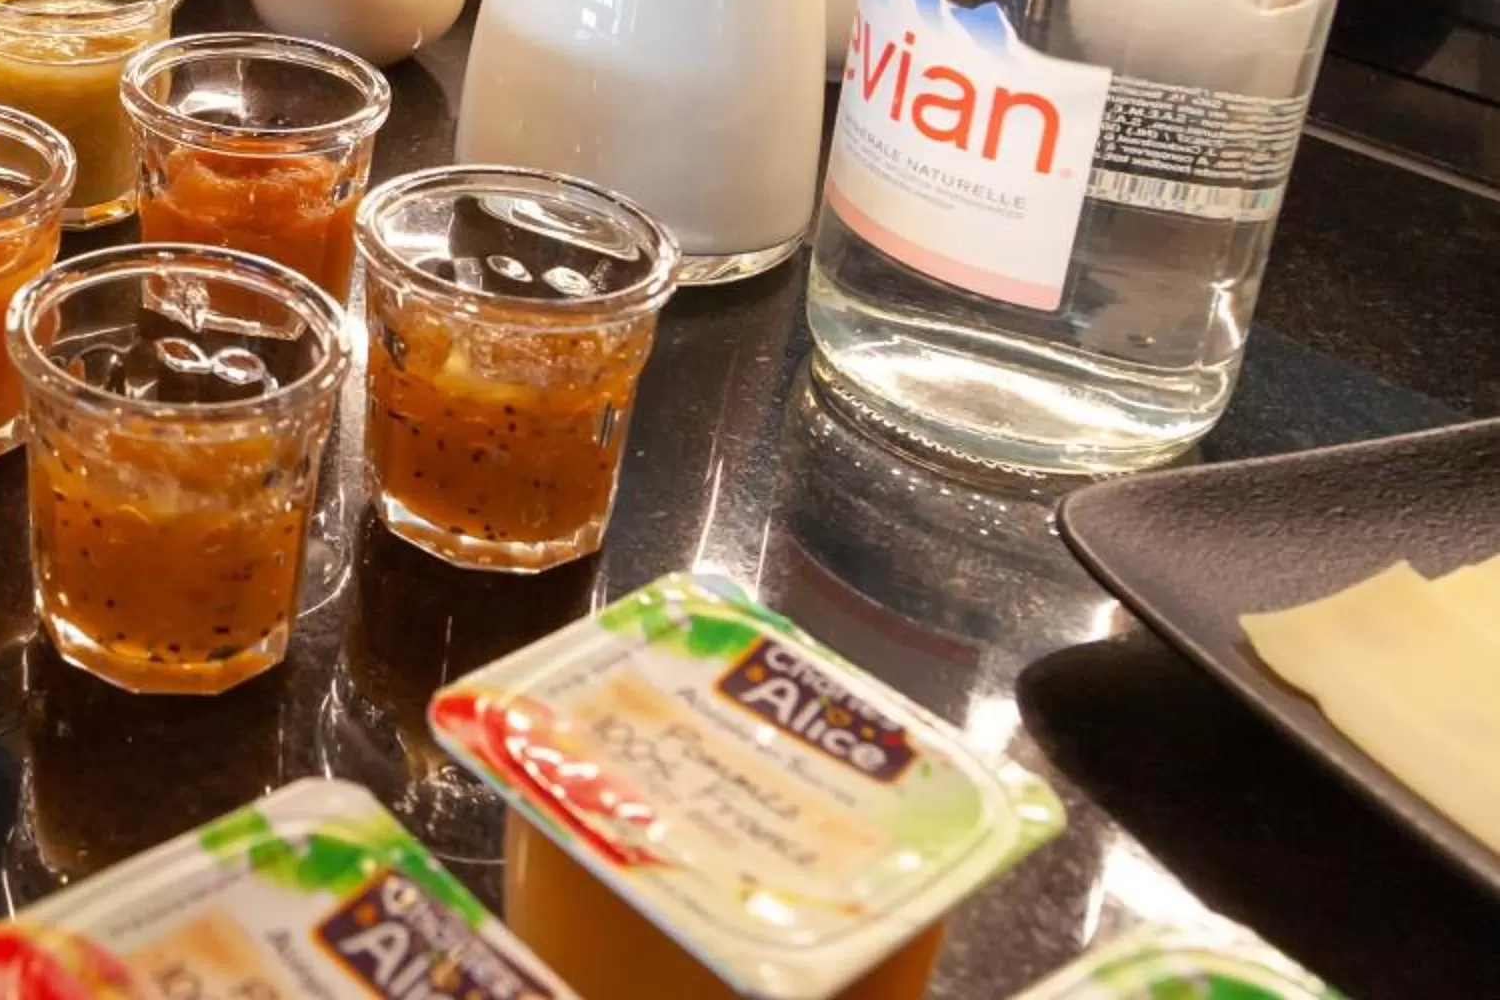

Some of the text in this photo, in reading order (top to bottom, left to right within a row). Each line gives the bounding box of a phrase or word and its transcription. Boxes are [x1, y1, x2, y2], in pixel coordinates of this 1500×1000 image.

[907, 156, 1027, 210] NATURELLE
[739, 677, 887, 771] Alice
[338, 921, 454, 1000] Ali
